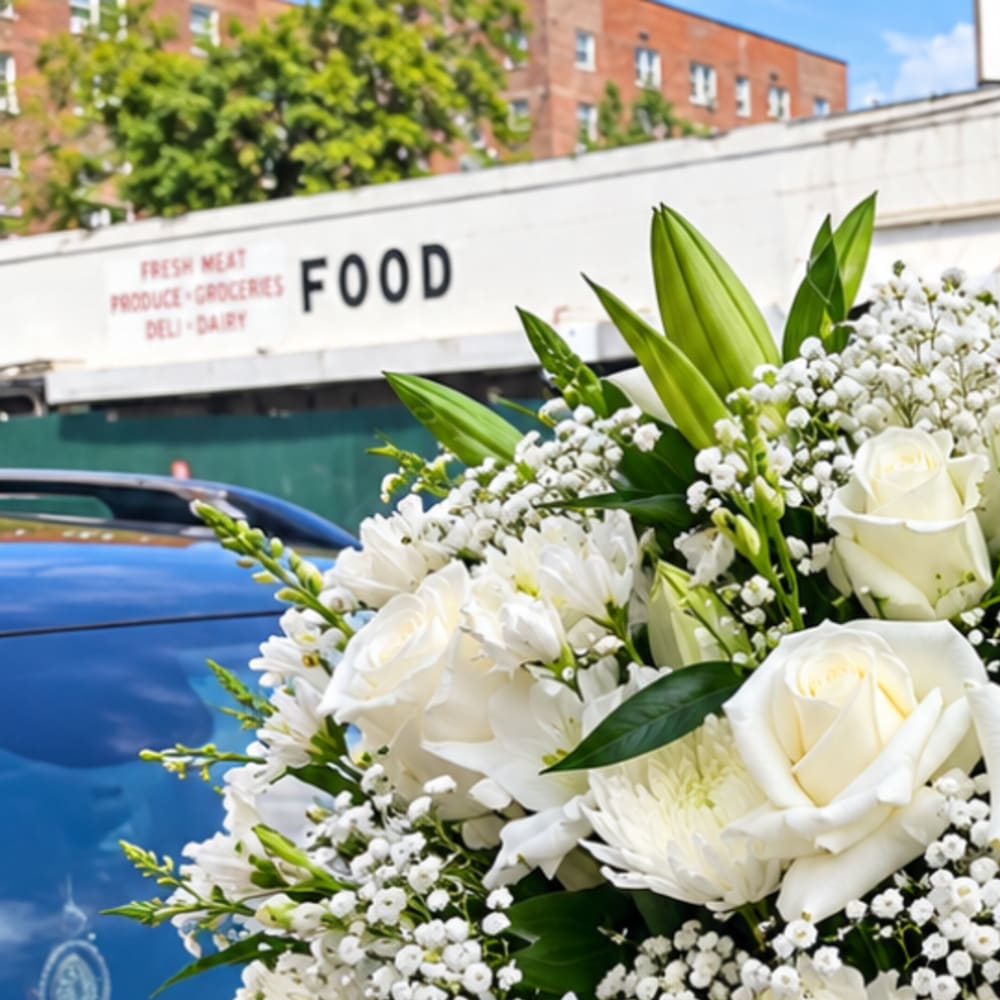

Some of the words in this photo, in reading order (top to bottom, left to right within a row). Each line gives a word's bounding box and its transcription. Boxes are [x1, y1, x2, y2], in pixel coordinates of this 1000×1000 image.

[140, 256, 194, 281] FRESH
[201, 248, 246, 273] MEAT
[301, 243, 453, 313] FOOD
[196, 310, 247, 335] DAIRY
